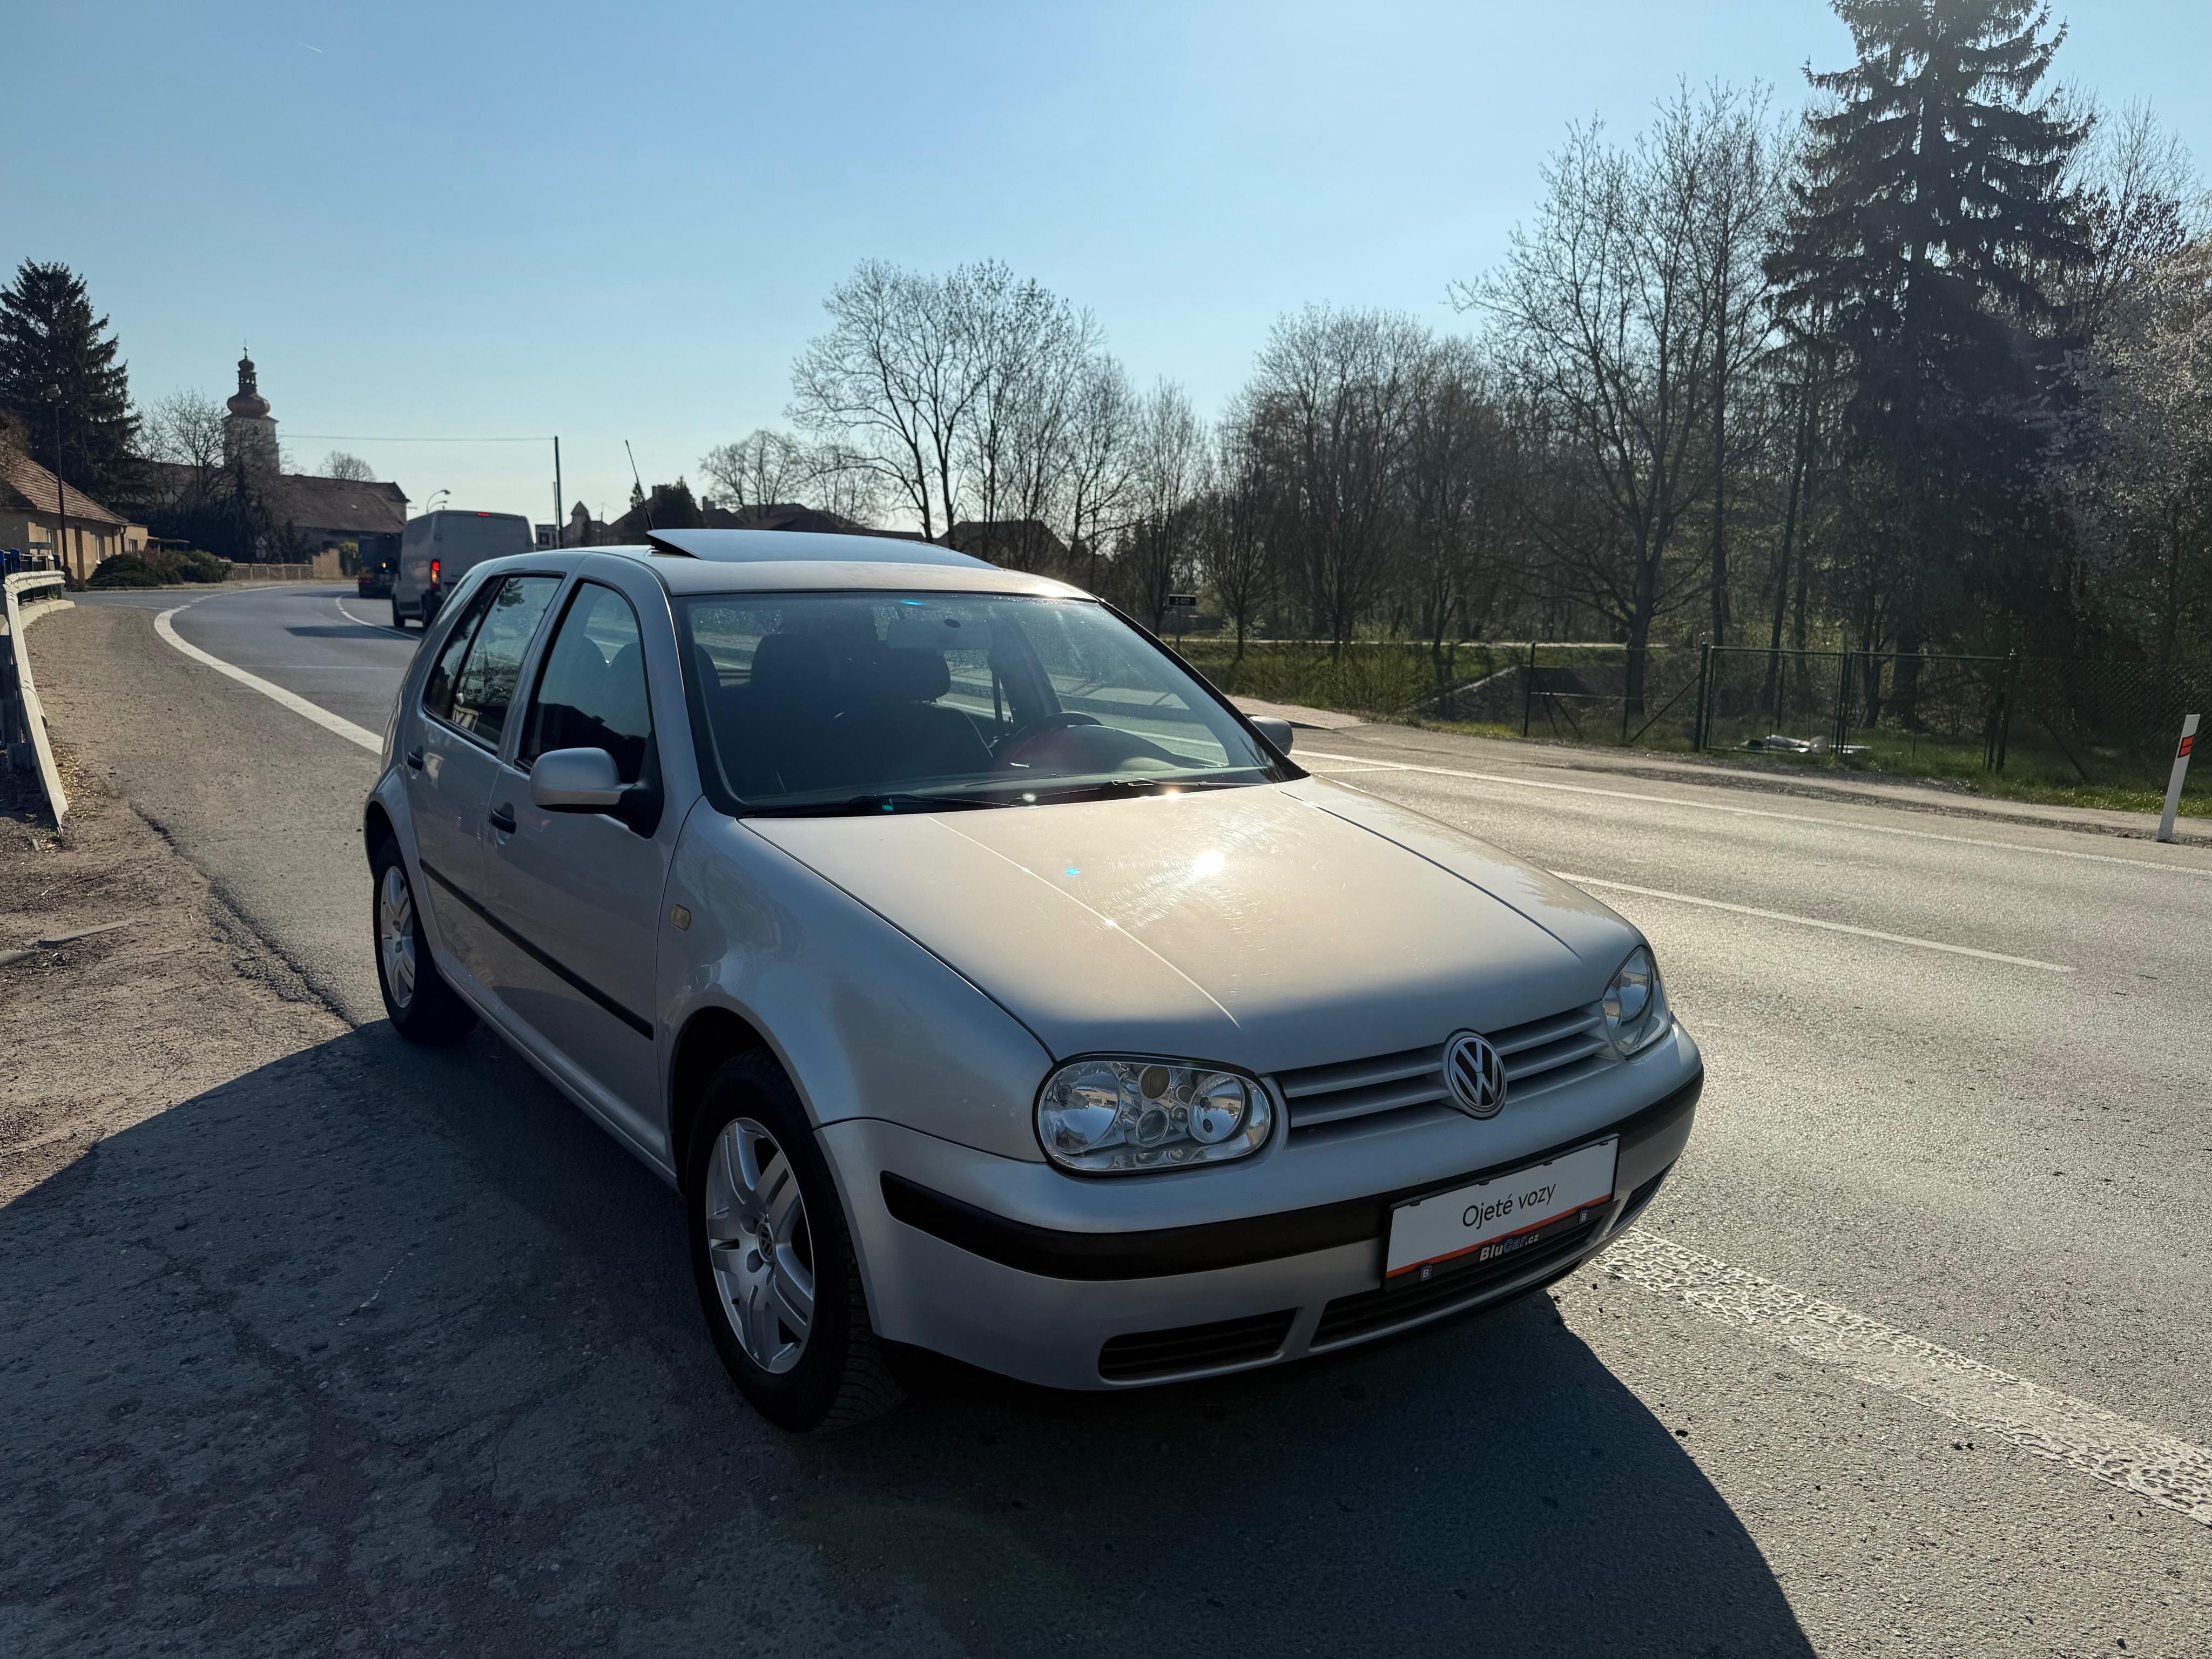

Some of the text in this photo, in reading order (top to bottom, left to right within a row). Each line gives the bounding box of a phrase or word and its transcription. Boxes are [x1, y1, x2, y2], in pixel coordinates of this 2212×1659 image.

[1449, 1037, 1504, 1111] VW
[1462, 1183, 1556, 1230] Ojeté vozy
[1480, 1234, 1539, 1262] BluCar.cz
